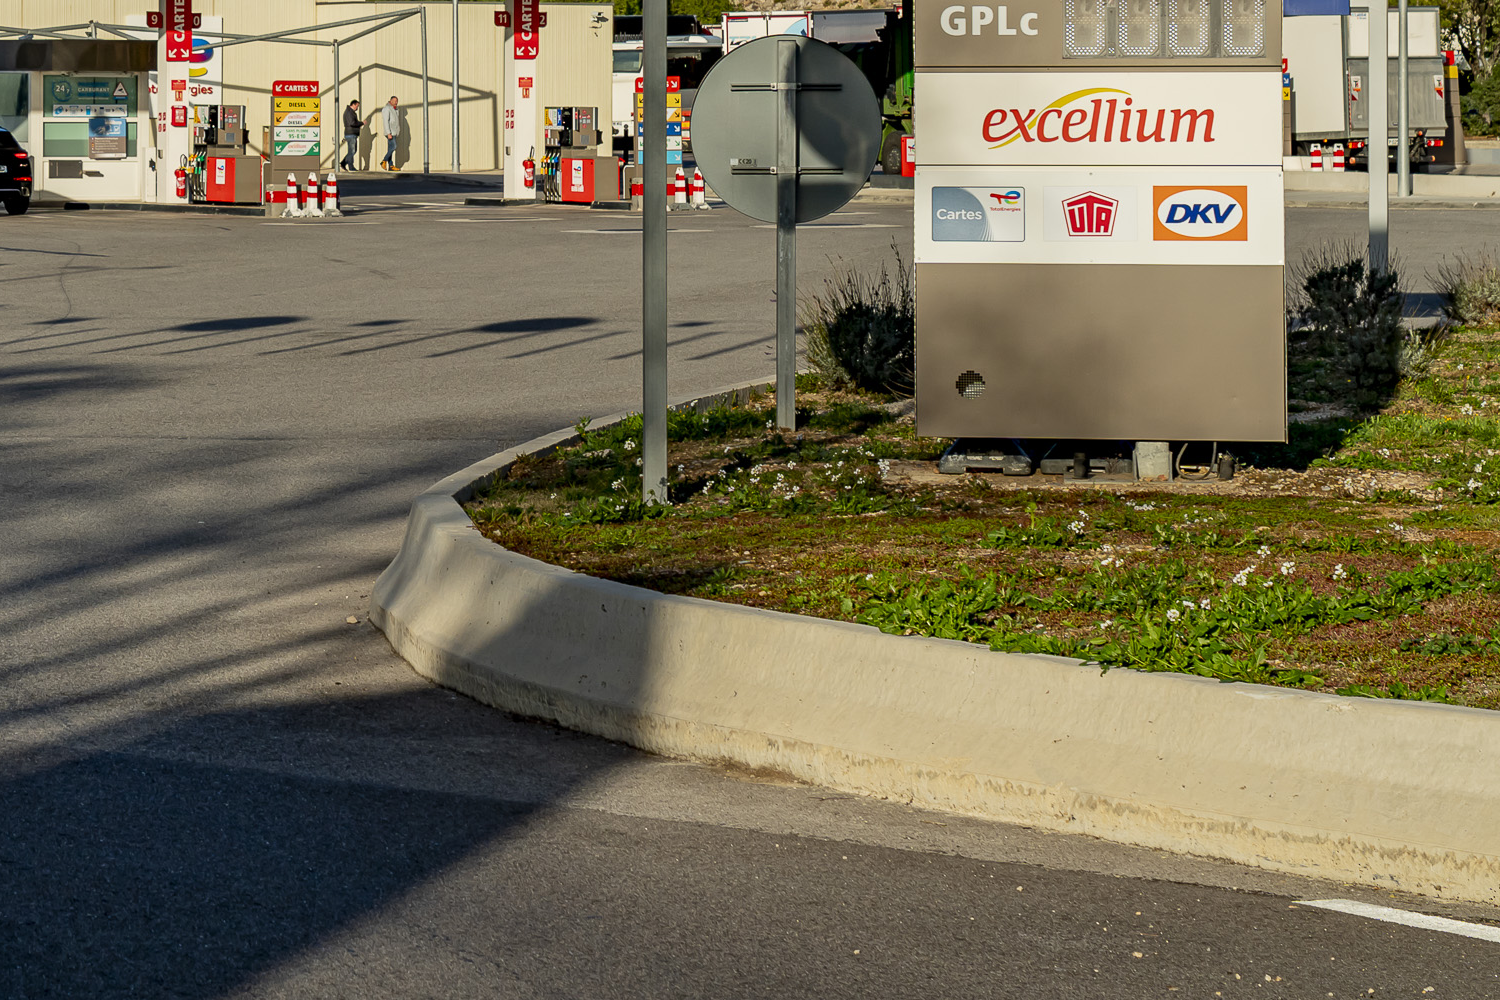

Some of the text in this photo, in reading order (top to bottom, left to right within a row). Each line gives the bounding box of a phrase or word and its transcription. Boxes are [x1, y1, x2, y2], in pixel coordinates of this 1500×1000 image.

[151, 14, 158, 25] 9
[193, 16, 200, 26] 0
[498, 14, 507, 23] 11
[540, 15, 546, 25] 2
[940, 6, 1038, 36] GPLc
[982, 97, 1215, 143] excellium
[936, 208, 983, 220] Cartes
[1165, 203, 1237, 224] DKV
